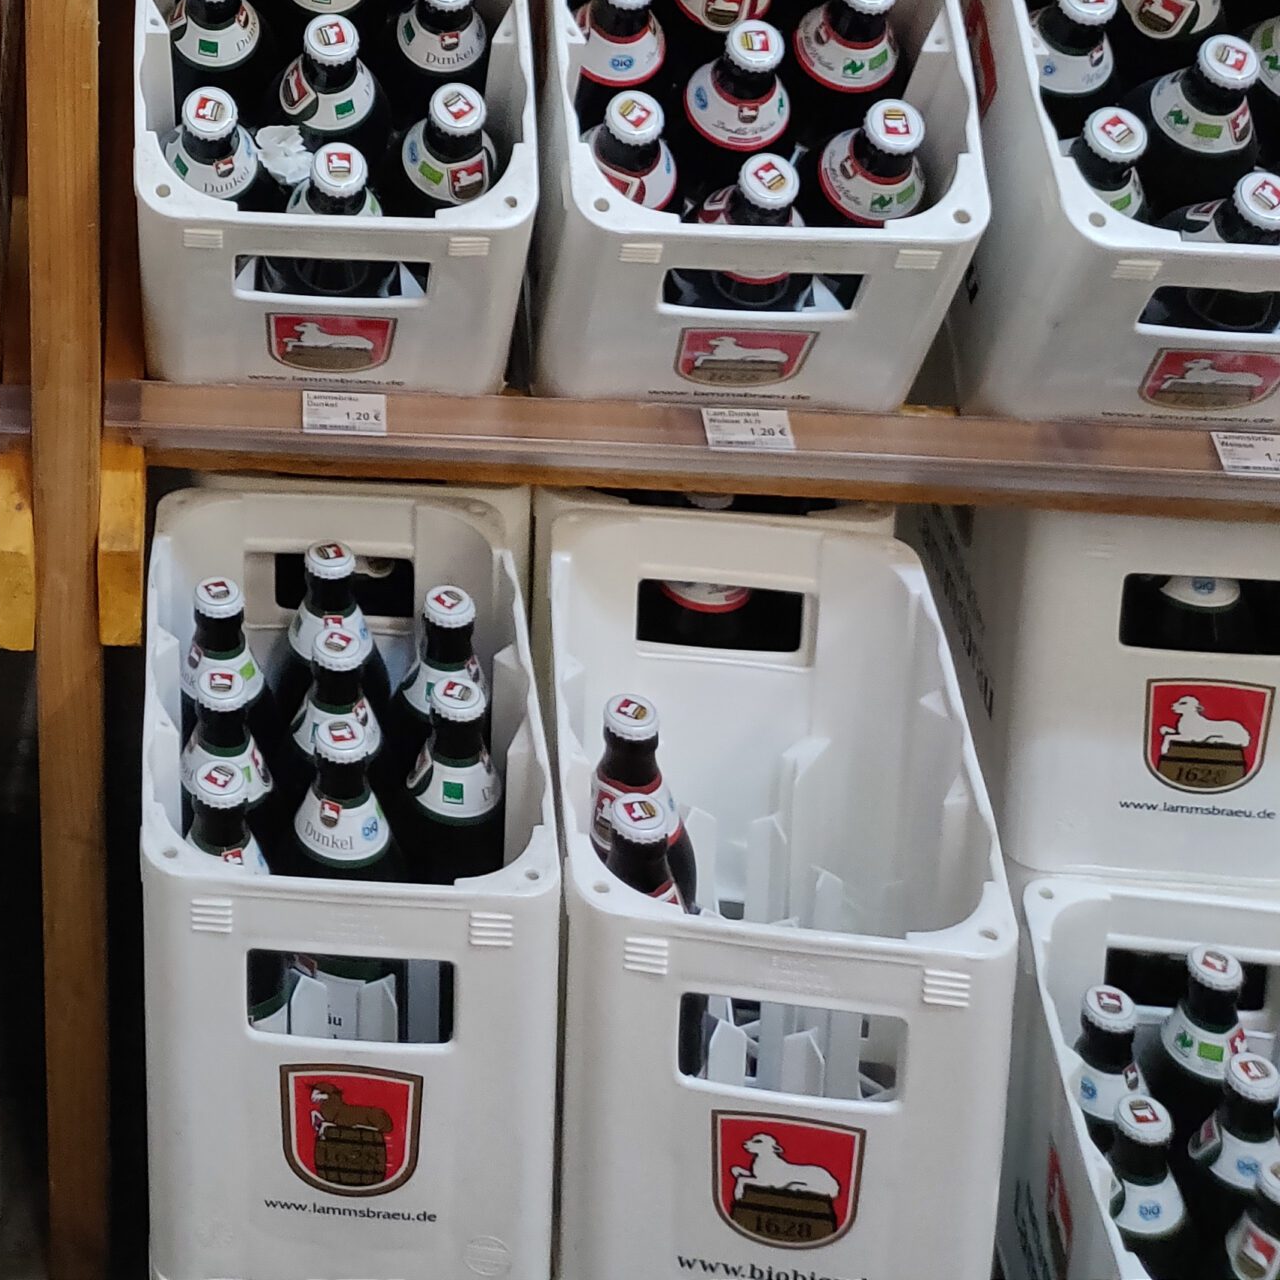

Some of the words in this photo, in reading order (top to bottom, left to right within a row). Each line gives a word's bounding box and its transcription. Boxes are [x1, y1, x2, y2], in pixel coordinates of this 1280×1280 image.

[425, 47, 475, 65] Dunkel
[204, 167, 250, 193] Dunkel
[1119, 800, 1276, 819] www.lammsbraeu.de
[305, 824, 354, 851] Dunkel
[264, 1198, 437, 1222] www.lammsbraeu.de
